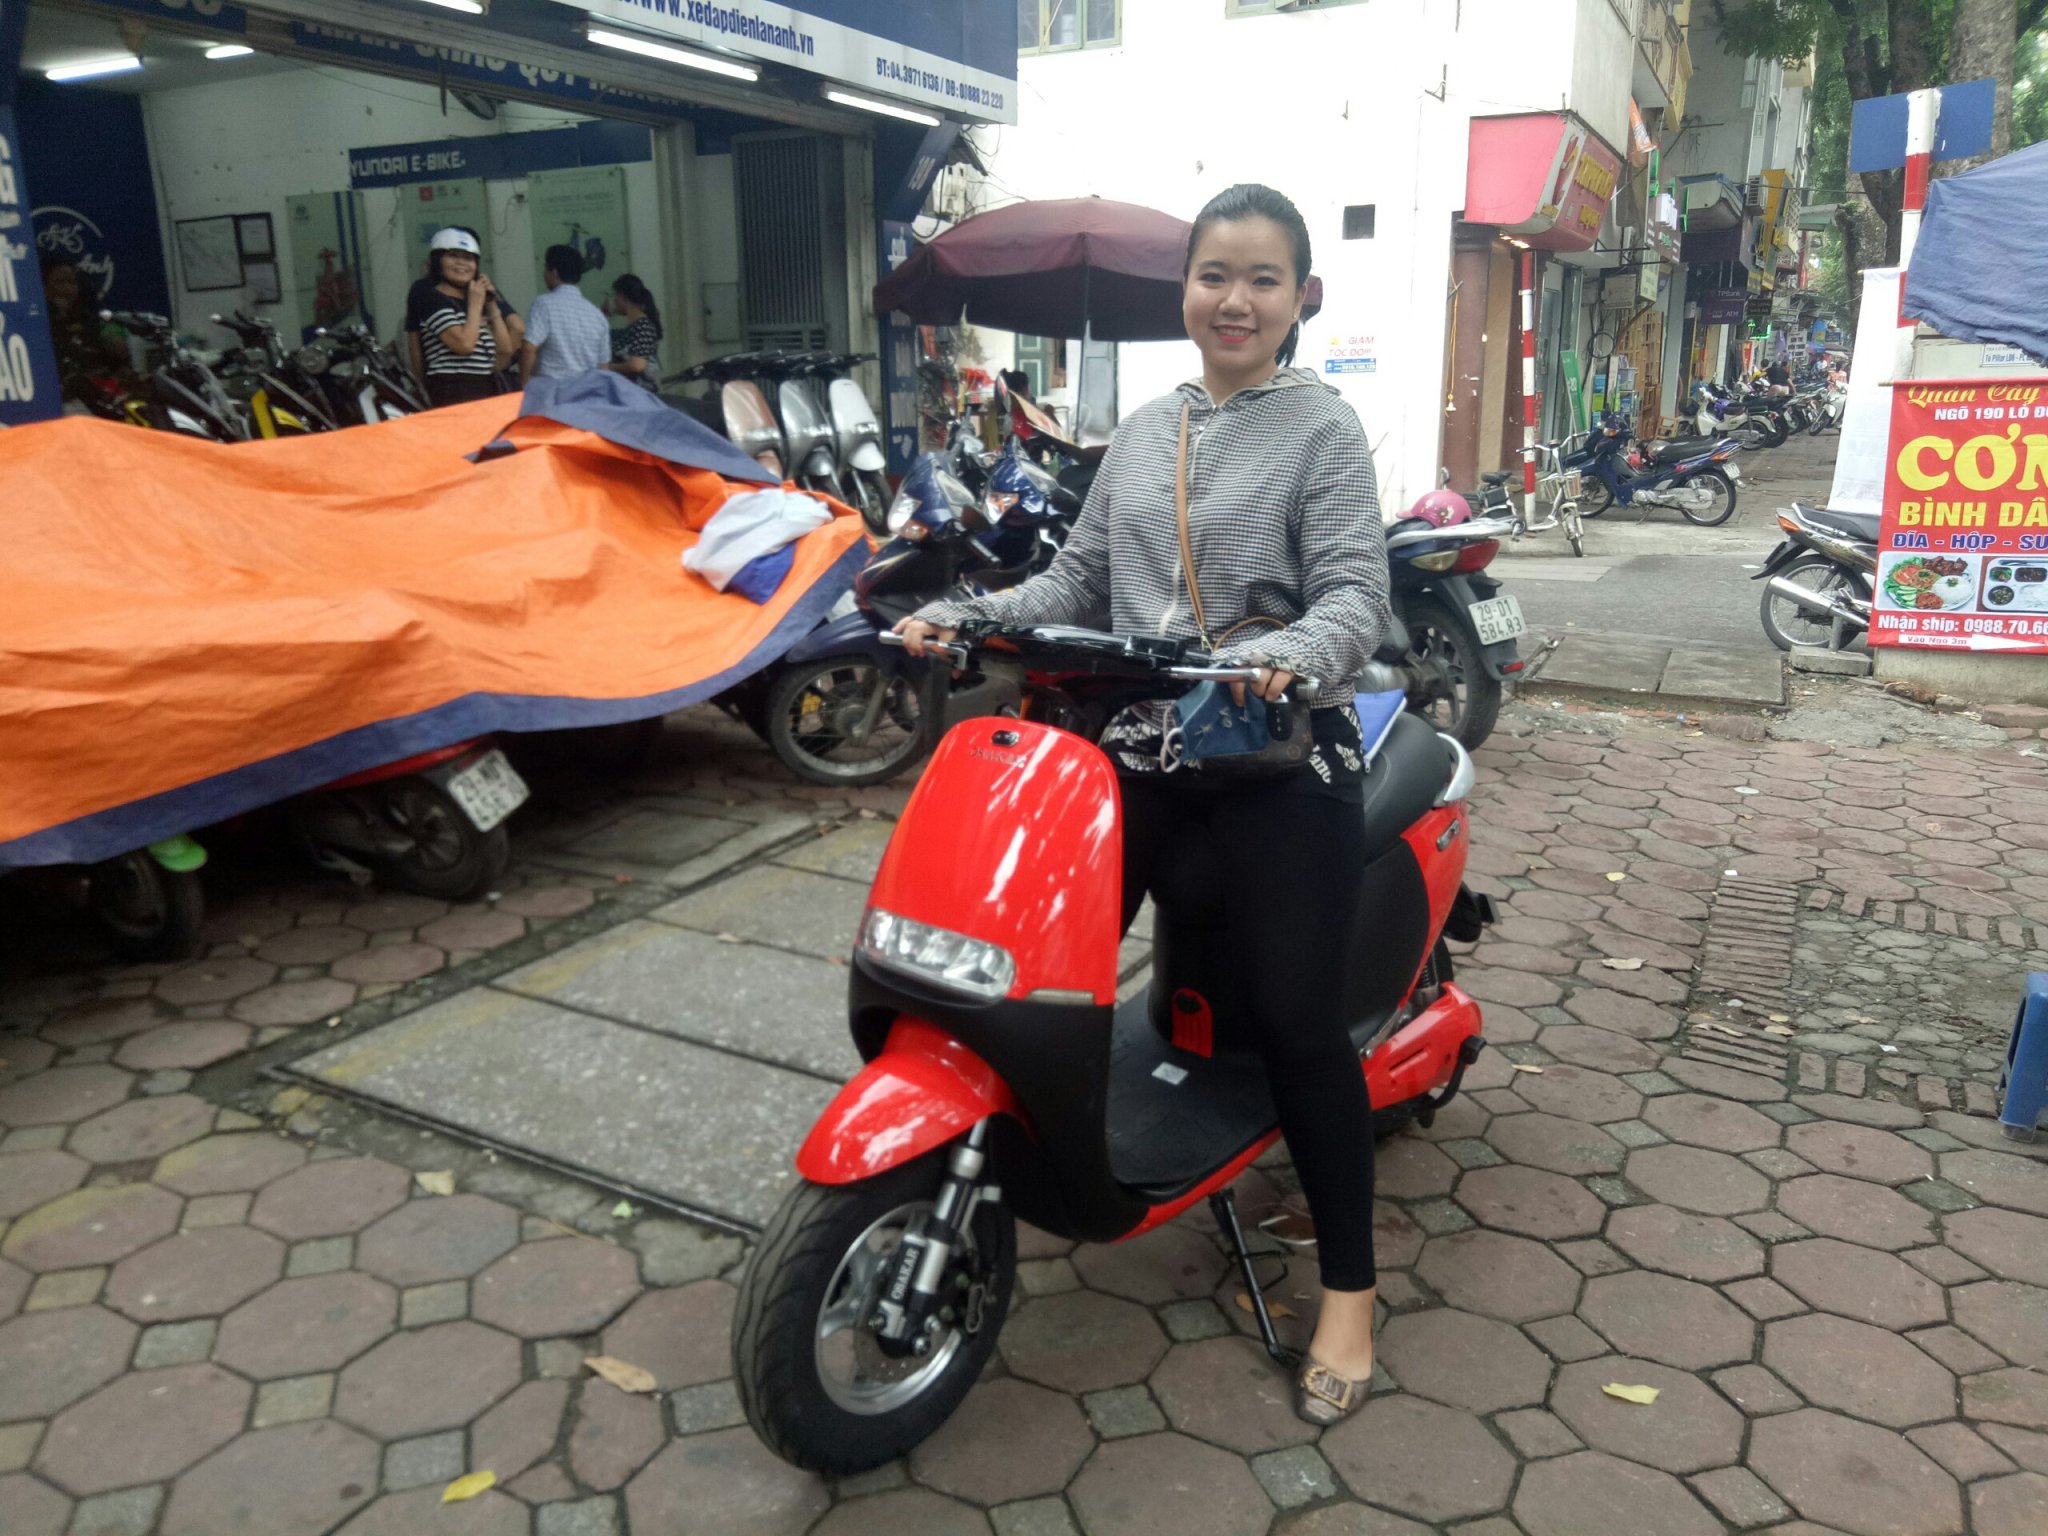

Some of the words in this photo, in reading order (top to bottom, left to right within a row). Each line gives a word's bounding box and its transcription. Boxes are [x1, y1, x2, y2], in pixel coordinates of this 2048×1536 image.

[1935, 406, 1968, 420] NGÕ
[1974, 408, 2004, 419] 190
[1898, 497, 1987, 527] BÌNH
[1892, 531, 1929, 548] ĐĨA
[1951, 531, 1996, 552] HỘP
[1480, 616, 1523, 641] 584.83
[1878, 614, 1917, 632] Nhận
[1921, 616, 1959, 632] ship:
